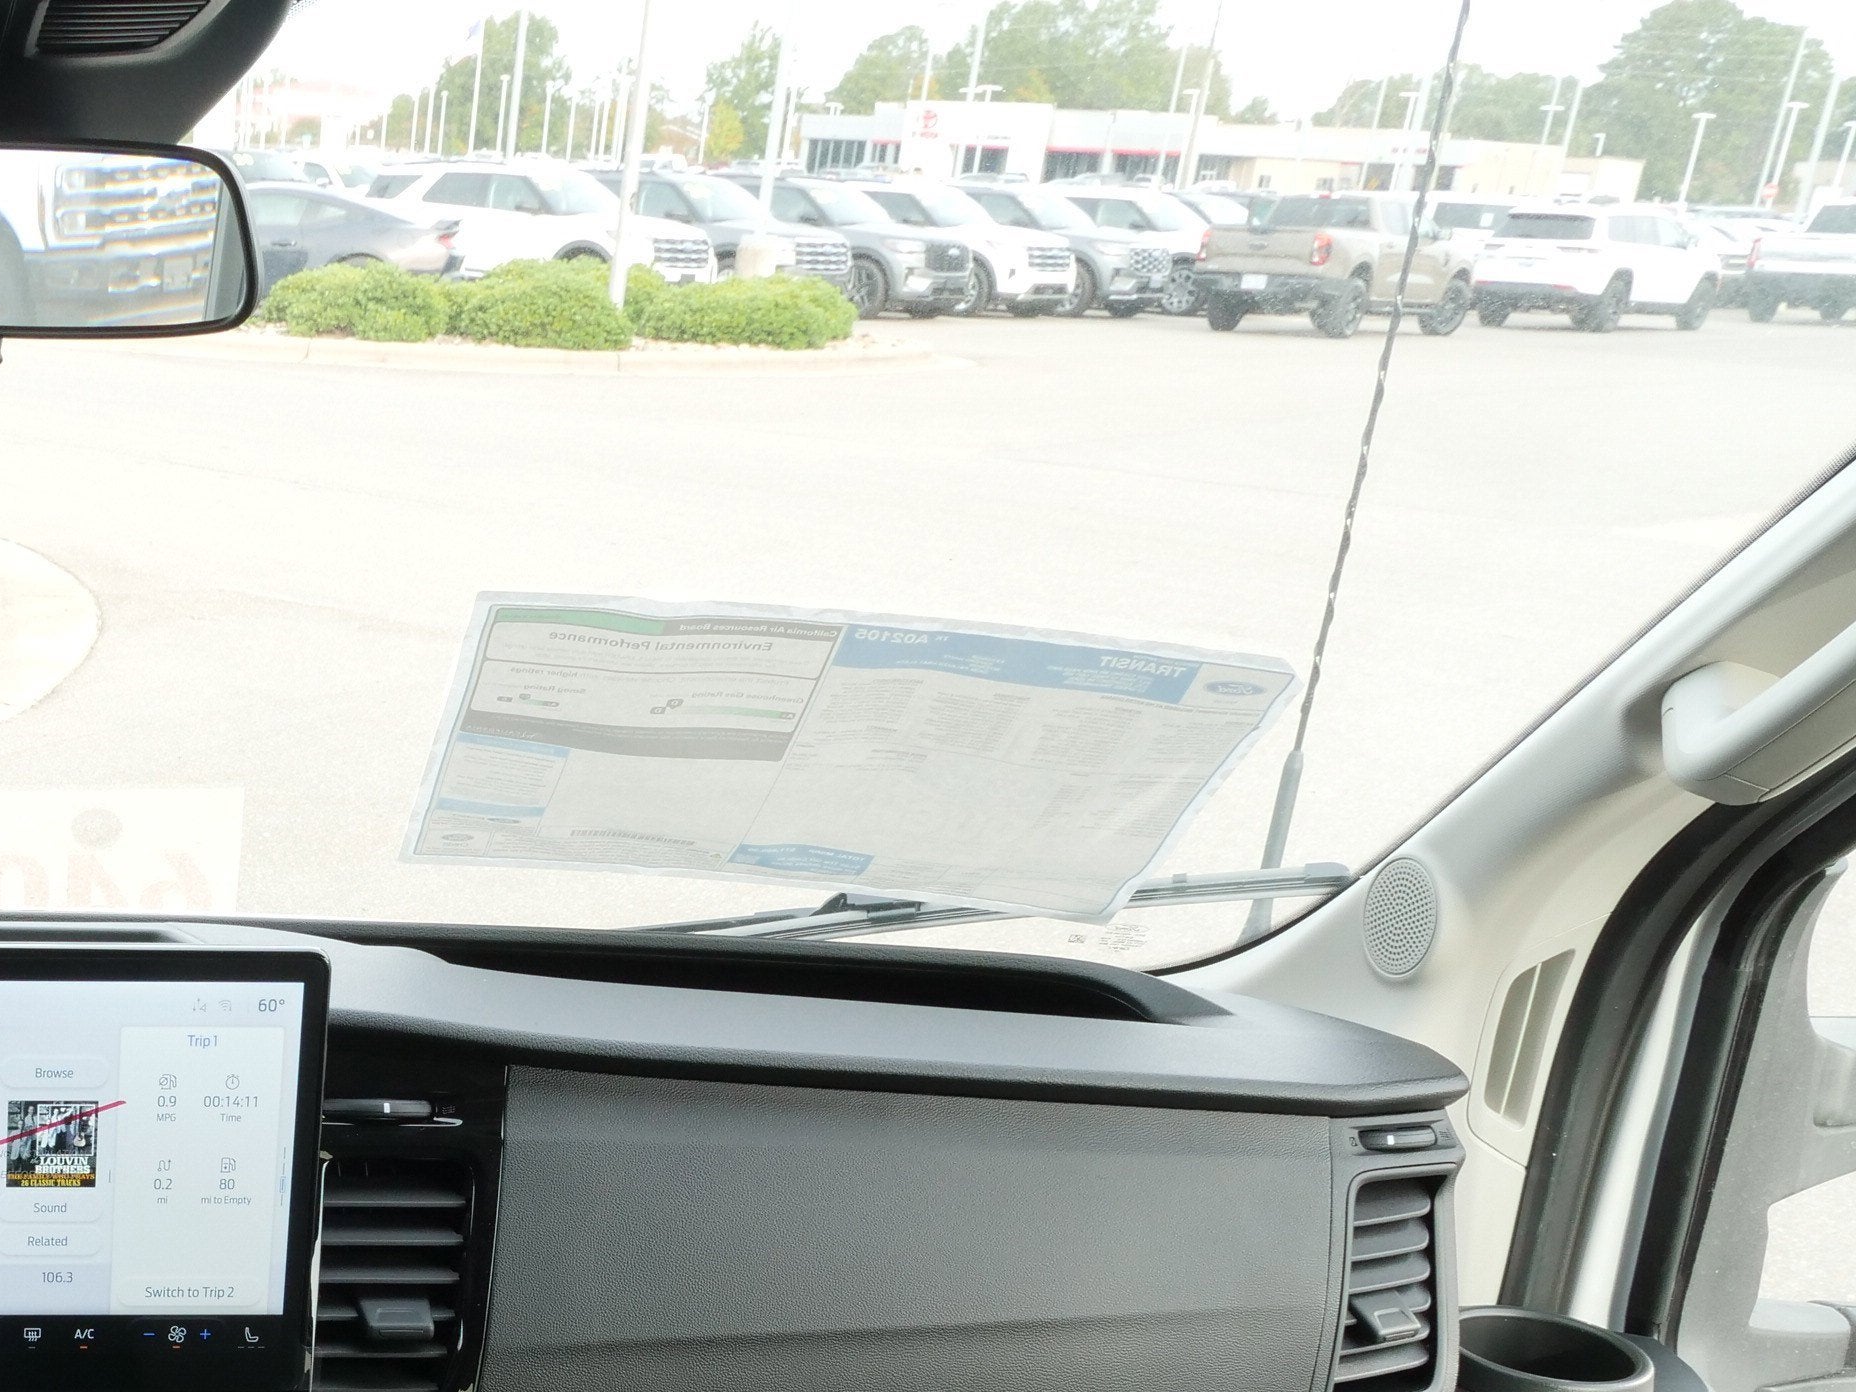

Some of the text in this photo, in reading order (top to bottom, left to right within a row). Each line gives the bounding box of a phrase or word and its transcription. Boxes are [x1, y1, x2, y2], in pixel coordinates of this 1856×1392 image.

[258, 998, 286, 1012] 60°
[188, 1035, 218, 1048] Trip 1
[35, 1067, 74, 1079] Browse
[157, 1095, 177, 1108] 0.9
[203, 1095, 259, 1108] 00:14:11
[156, 1113, 177, 1122] MPG
[220, 1113, 242, 1123] Time
[39, 1156, 89, 1166] LOUVIN
[35, 1165, 91, 1174] BROTHERS
[154, 1178, 173, 1190] 0.2
[219, 1178, 235, 1190] 80
[157, 1196, 168, 1204] mi
[201, 1196, 252, 1206] mi to Empty
[33, 1203, 67, 1214] Sound
[27, 1236, 68, 1247] Related
[41, 1271, 74, 1284] 106.3
[145, 1286, 235, 1300] Switch to Trip 2
[74, 1328, 95, 1341] A/C
